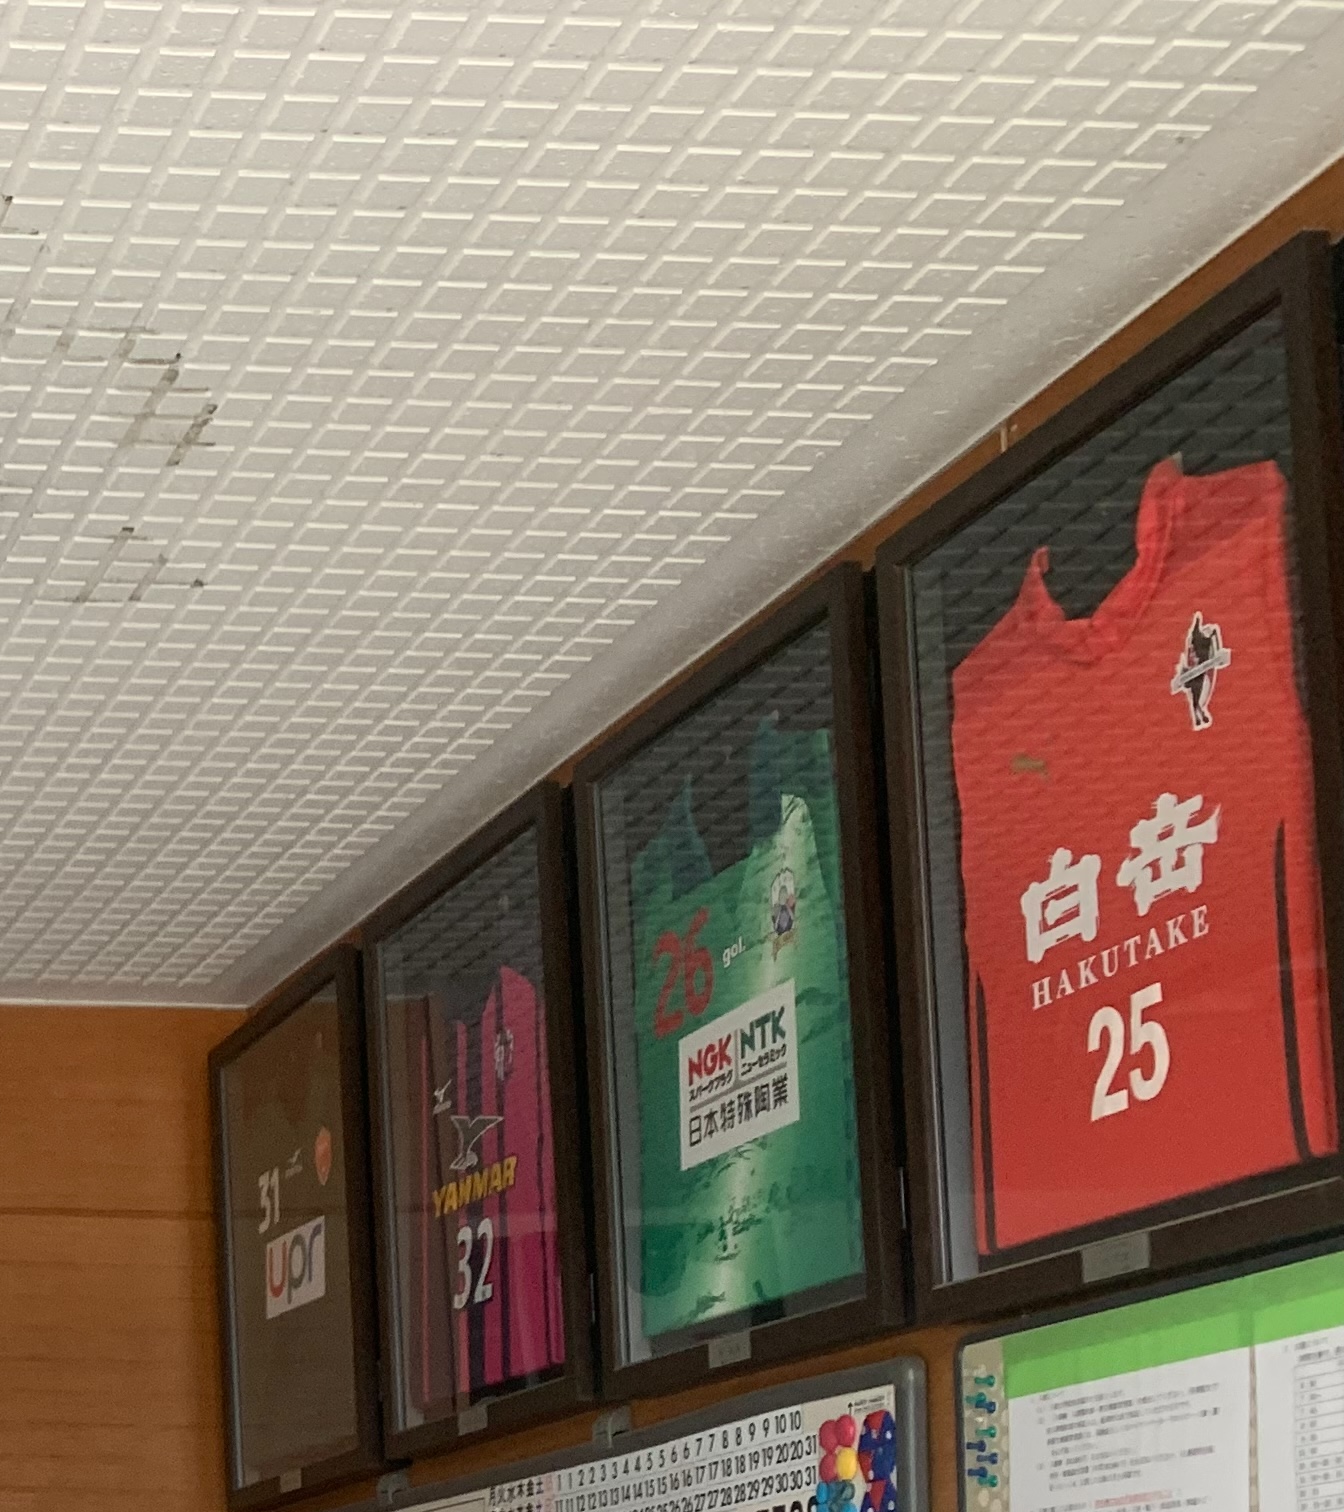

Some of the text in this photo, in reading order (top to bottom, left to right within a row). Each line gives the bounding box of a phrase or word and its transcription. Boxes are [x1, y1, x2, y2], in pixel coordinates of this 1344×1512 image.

[1021, 792, 1221, 963] 白岳
[653, 906, 714, 1039] 26
[1032, 904, 1210, 1011] HAKUTAKE
[688, 1006, 787, 1086] NGK NTK
[1087, 982, 1170, 1122] 25
[689, 1072, 789, 1147] 日本特殊陶業
[258, 1166, 280, 1234] 31
[428, 1155, 517, 1218] YANMAR
[269, 1223, 322, 1305] upr
[453, 1217, 494, 1310] 32
[558, 1411, 801, 1491] 1 1 2 2 3 3 4 4 5 5 6 6 7 7 8 8 9 9 10 10
[576, 1495, 585, 1512] 12
[588, 1493, 596, 1510] 12
[599, 1490, 607, 1507] 13
[610, 1488, 619, 1505] 13
[622, 1485, 630, 1502] 14
[633, 1482, 642, 1500] 14
[645, 1479, 654, 1497] 15
[658, 1476, 667, 1495] 15
[670, 1473, 679, 1490] 16
[682, 1469, 692, 1487] 16
[696, 1466, 706, 1484] 17
[709, 1461, 718, 1480] 17
[722, 1458, 731, 1477] 18
[735, 1455, 745, 1474] 18
[749, 1451, 759, 1471] 19
[762, 1446, 773, 1467] 19
[776, 1443, 788, 1464] 20
[791, 1440, 803, 1460] 20
[806, 1435, 817, 1455] 31
[694, 1493, 706, 1512] 27
[707, 1489, 719, 1509] 27
[721, 1487, 732, 1506] 28
[734, 1483, 746, 1503] 28
[747, 1480, 760, 1500] 29
[762, 1476, 774, 1496] 29
[776, 1473, 788, 1493] 30
[790, 1470, 803, 1490] 30
[805, 1465, 816, 1486] 31
